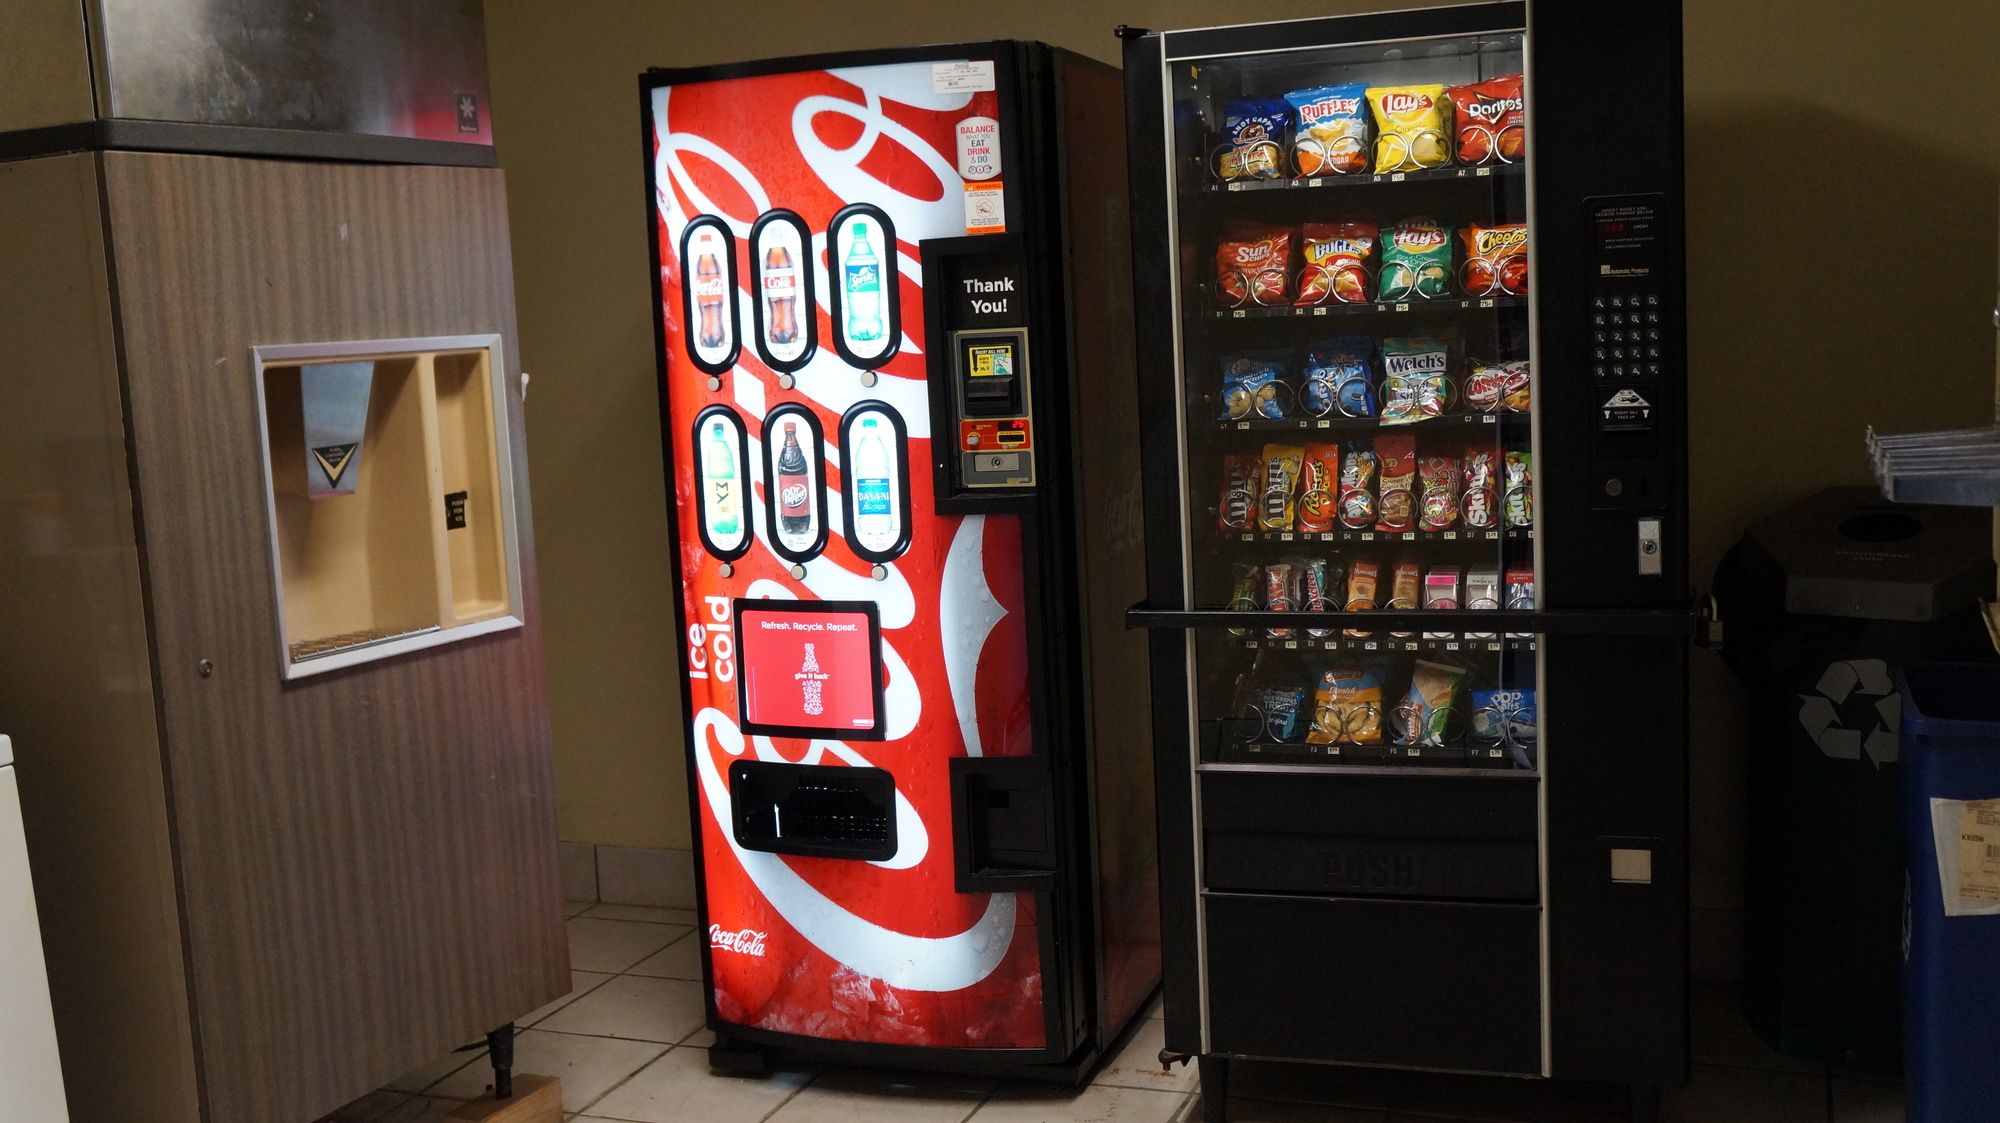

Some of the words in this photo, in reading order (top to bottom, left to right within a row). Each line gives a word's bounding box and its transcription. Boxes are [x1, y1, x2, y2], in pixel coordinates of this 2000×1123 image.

[1299, 97, 1357, 125] RUFFLES
[1468, 97, 1523, 117] Doritos
[960, 125, 996, 135] BALANCE
[967, 147, 991, 156] DRINK
[1235, 245, 1269, 263] Sun
[767, 277, 792, 289] Coke
[963, 276, 1015, 293] Thank
[971, 298, 1008, 314] You!
[1389, 355, 1445, 373] Welch's
[1011, 420, 1025, 429] 25
[761, 620, 791, 631] Refresh.
[792, 621, 825, 632] Recycle.
[826, 622, 858, 632] Repeat.
[705, 595, 735, 683] cold
[689, 622, 709, 680] ice
[794, 672, 806, 681] give
[1328, 687, 1356, 696] Danish
[708, 923, 769, 958] Coca-Cola
